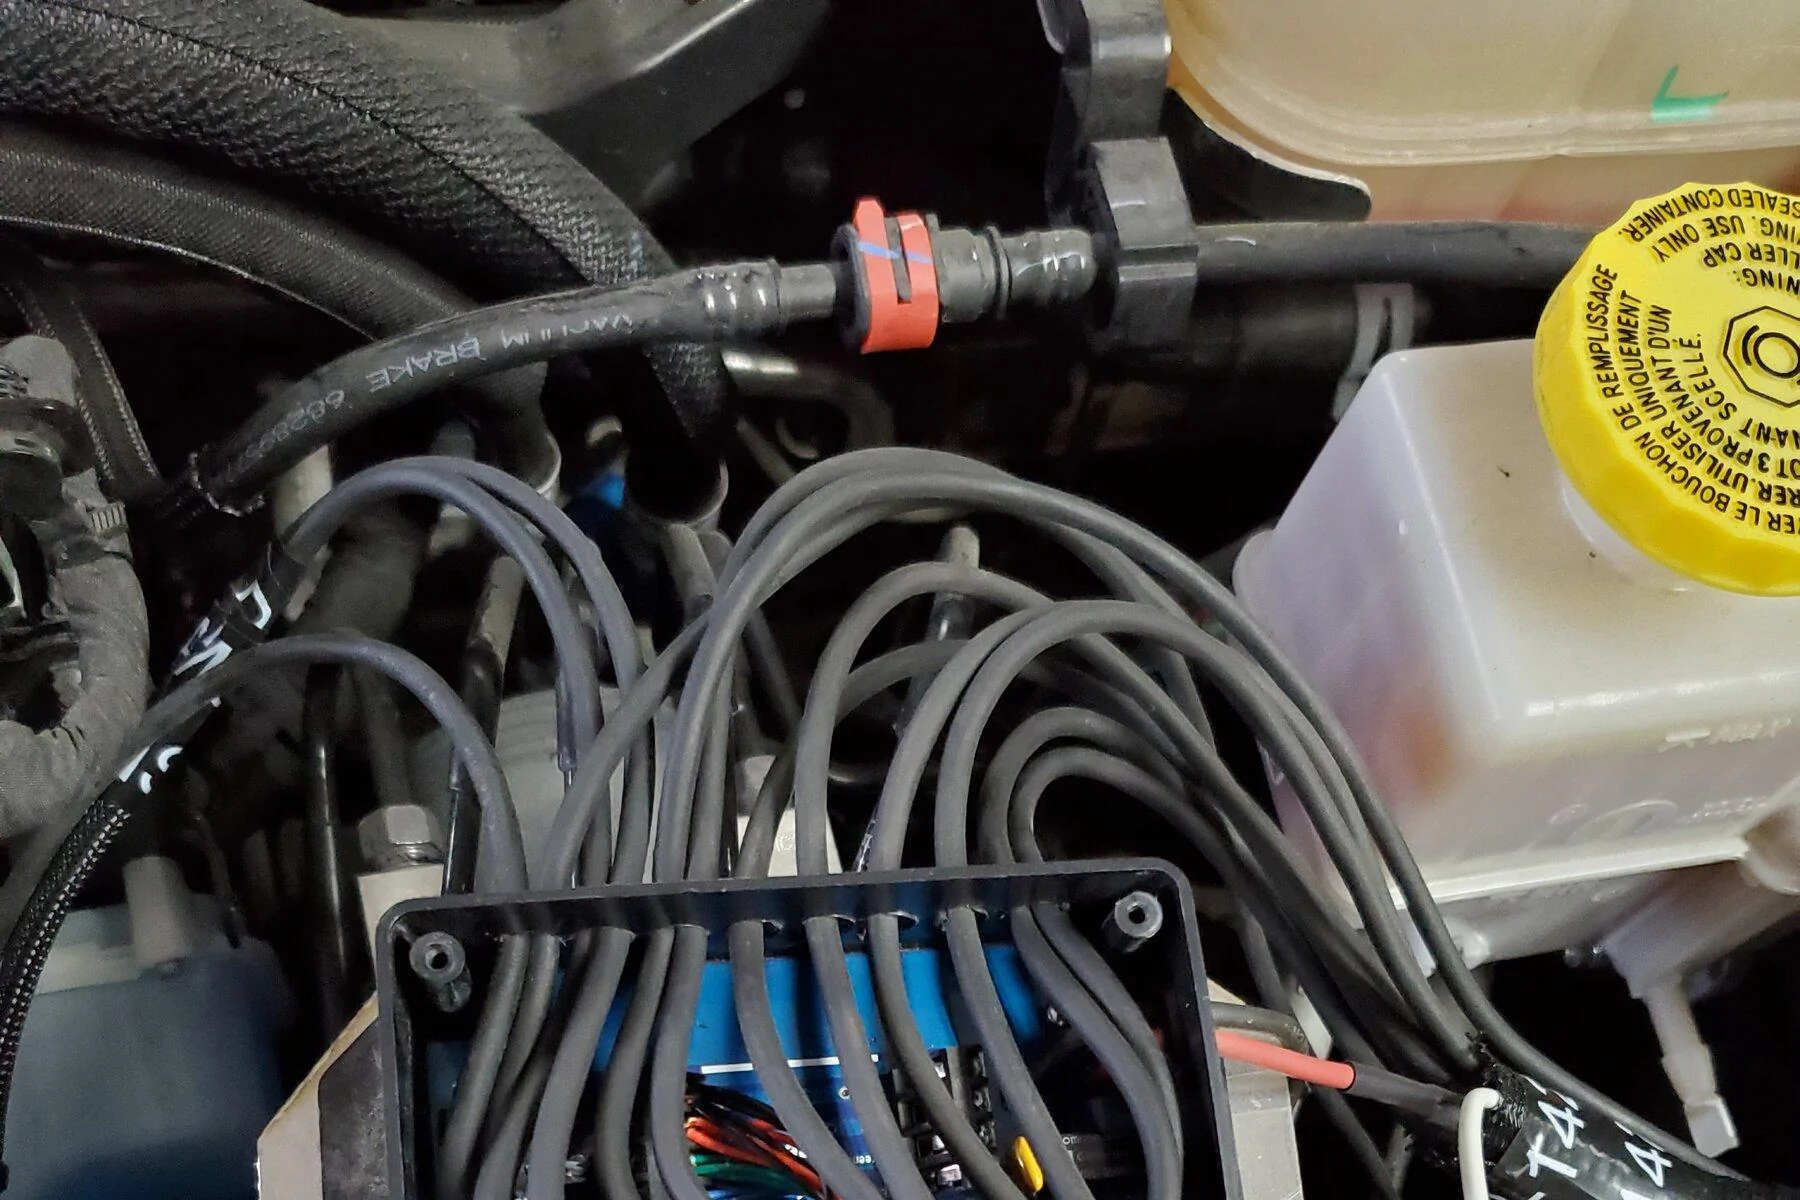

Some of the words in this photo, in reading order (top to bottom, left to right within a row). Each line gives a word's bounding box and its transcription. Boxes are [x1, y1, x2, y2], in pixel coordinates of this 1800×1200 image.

[1618, 188, 1724, 243] CONTAINER.
[1701, 215, 1746, 238] USE
[1752, 215, 1800, 246] ING.
[1652, 223, 1701, 263] ONLY
[1703, 242, 1742, 268] CAP
[1585, 263, 1625, 399] REMPLISSAGE
[1647, 304, 1672, 350] D'UN
[365, 335, 482, 393] BRAKE
[1616, 289, 1668, 421] UNIQUEMENT
[1612, 402, 1642, 431] DE
[1650, 355, 1754, 467] PROVENANT
[1634, 431, 1731, 513] BOUCHON
[1660, 420, 1749, 494] UTILISER
[1757, 452, 1771, 474] 3
[1734, 500, 1761, 526] LE
